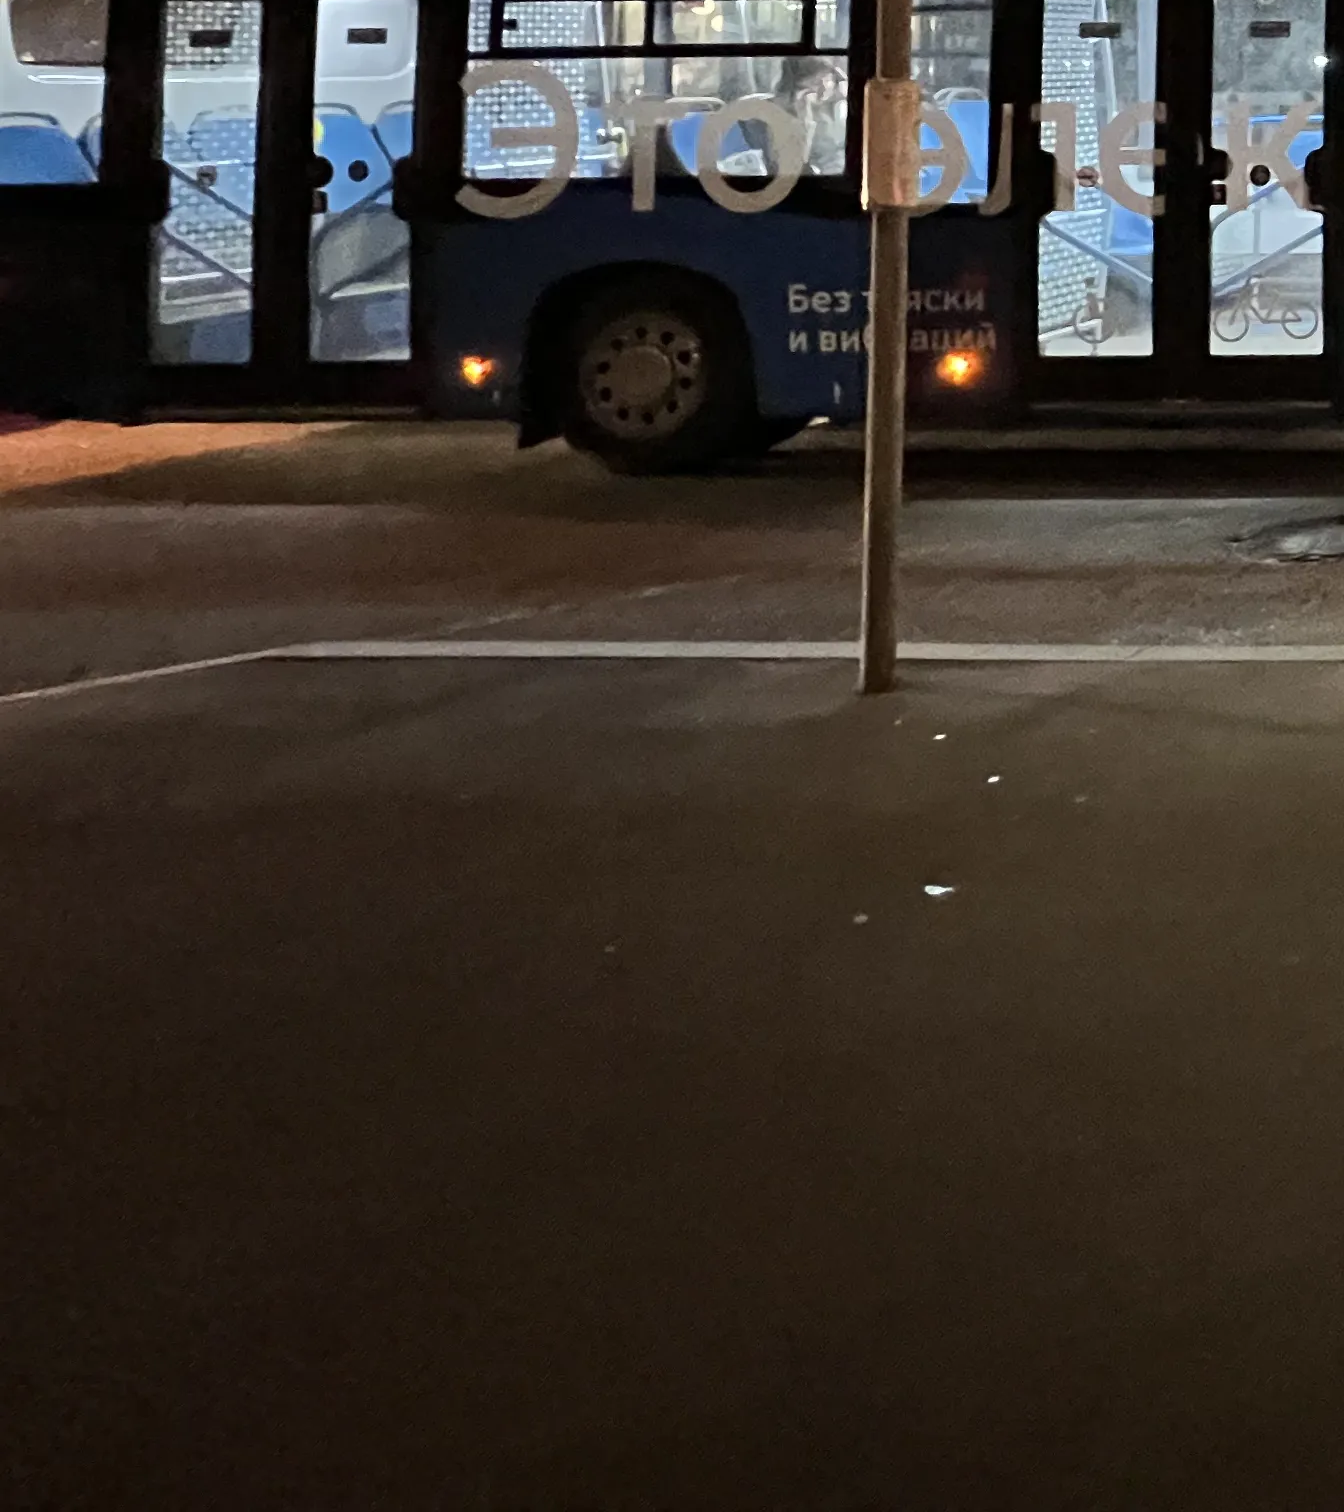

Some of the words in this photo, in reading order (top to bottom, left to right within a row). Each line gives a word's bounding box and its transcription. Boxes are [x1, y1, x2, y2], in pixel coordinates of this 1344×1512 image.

[454, 61, 810, 220] Это
[787, 283, 852, 314] Без
[788, 329, 809, 354] и
